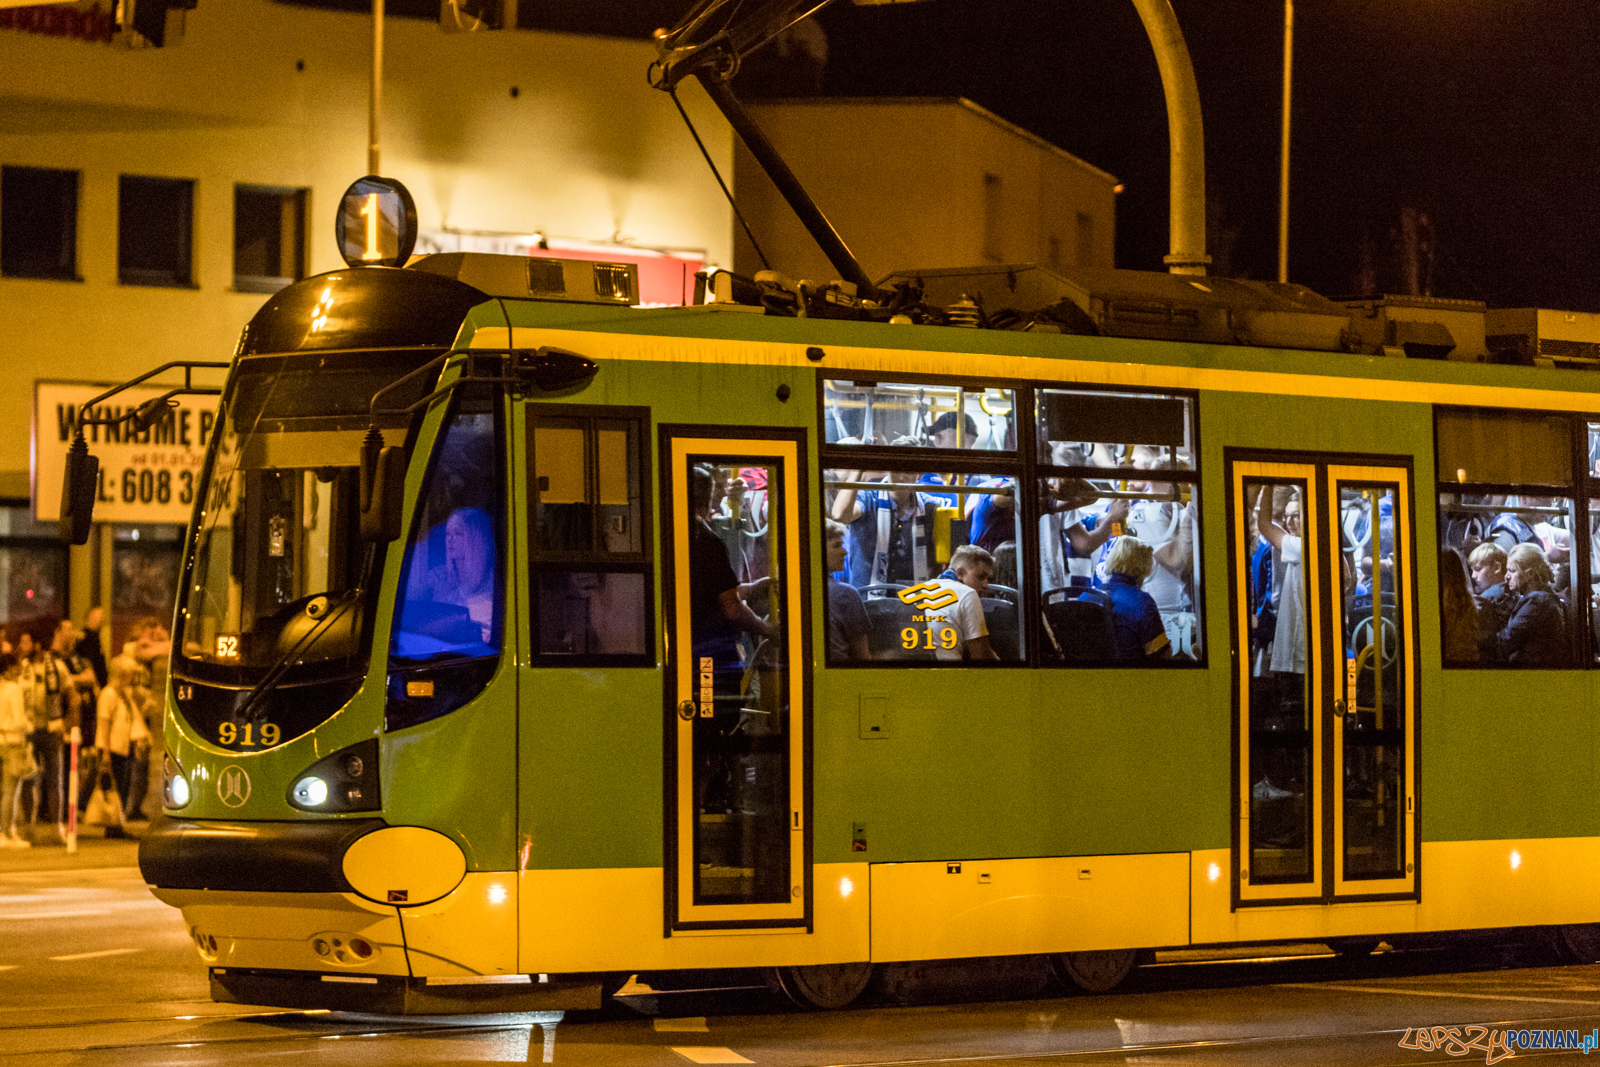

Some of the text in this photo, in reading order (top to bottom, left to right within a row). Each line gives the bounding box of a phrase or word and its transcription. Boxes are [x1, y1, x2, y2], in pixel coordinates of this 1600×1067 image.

[361, 193, 382, 261] 1
[121, 467, 171, 505] 608
[179, 469, 194, 505] 3
[911, 614, 946, 622] MPK
[217, 636, 238, 657] 52
[900, 627, 958, 650] 919
[218, 722, 281, 746] 919
